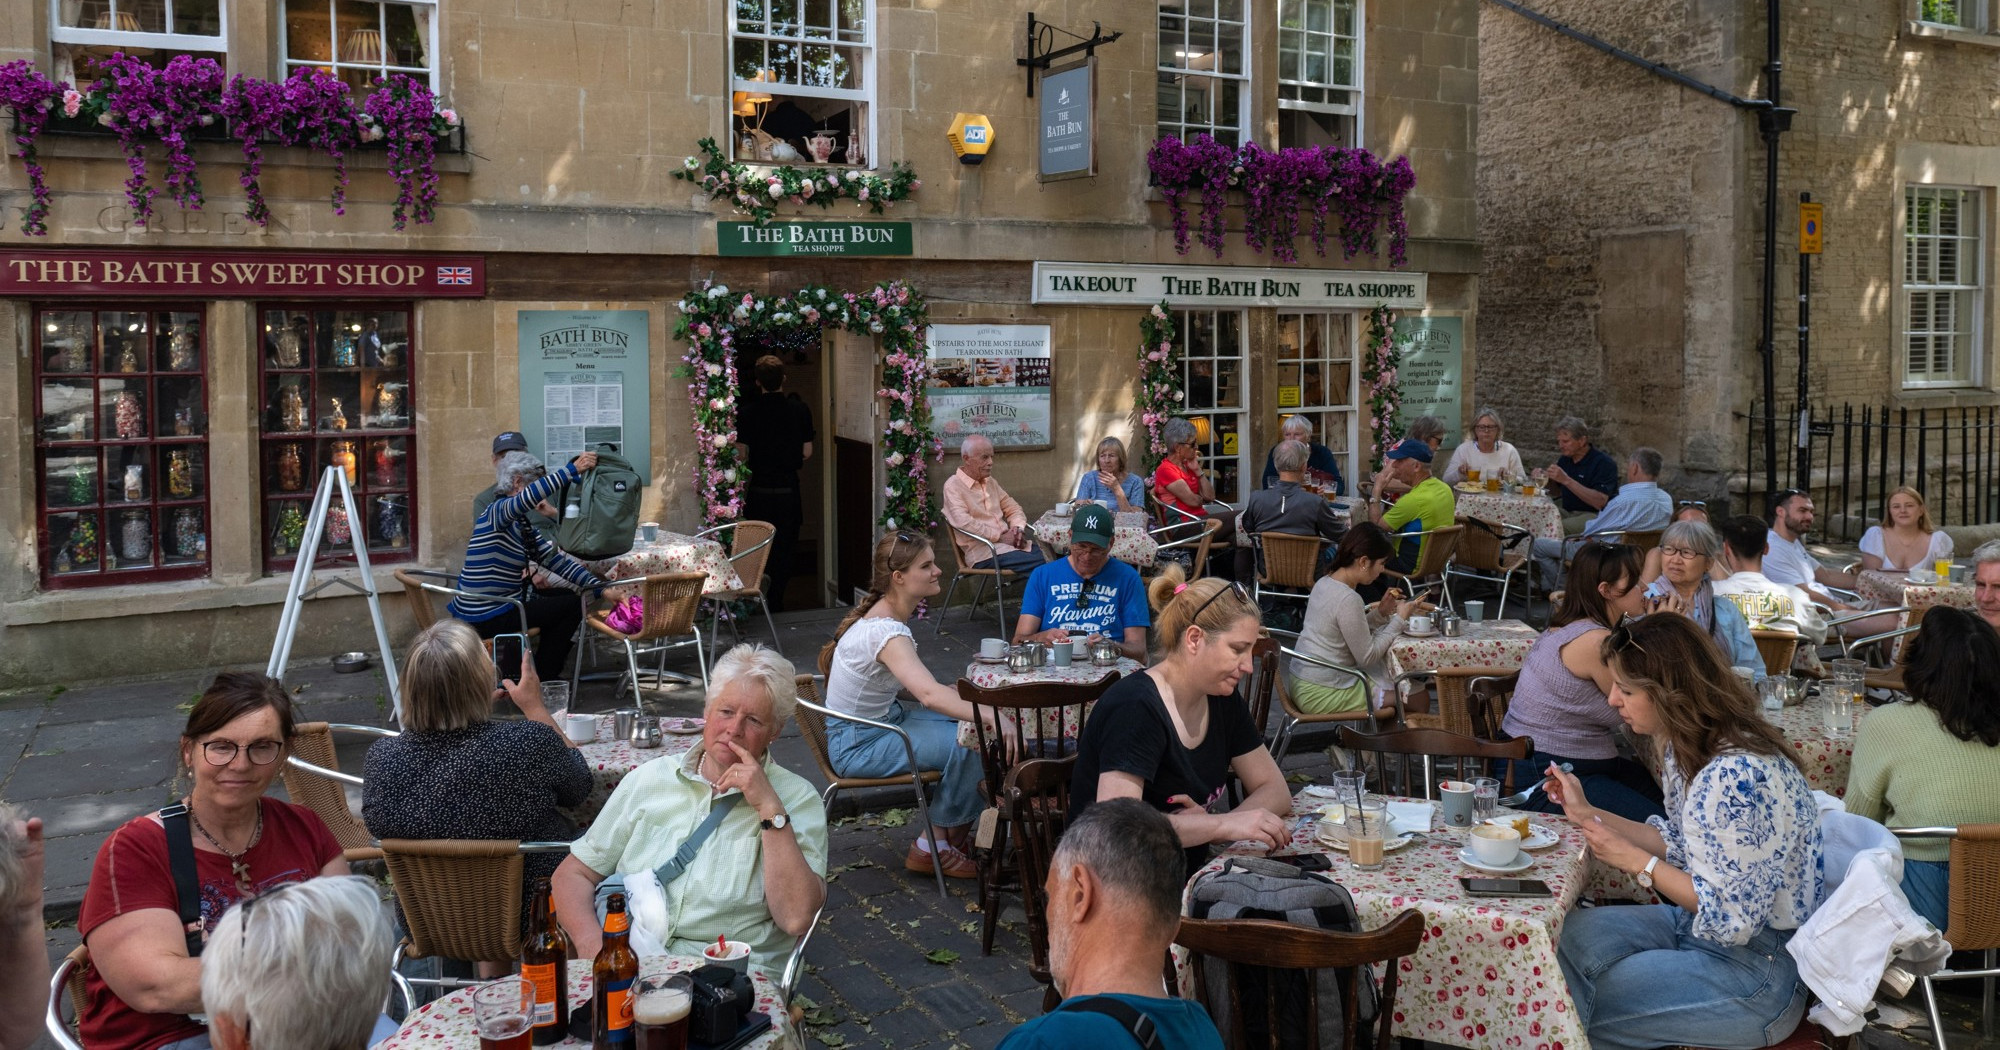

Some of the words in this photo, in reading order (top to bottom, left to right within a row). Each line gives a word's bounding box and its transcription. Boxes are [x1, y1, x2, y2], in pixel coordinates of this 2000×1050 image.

[1058, 111, 1069, 122] THE
[965, 129, 986, 140] ADT
[1047, 125, 1066, 139] BATH
[1067, 121, 1082, 135] BUN
[97, 205, 298, 237] GREEN
[738, 225, 784, 243] THE
[788, 225, 845, 243] BATH
[850, 225, 894, 243] BUN
[9, 260, 93, 283] THE
[101, 261, 202, 284] BATH
[211, 262, 331, 285] SWEET
[337, 264, 425, 286] SHOP
[1049, 275, 1136, 293] TAKEOUT
[1162, 276, 1202, 296] THE
[1206, 277, 1257, 297] BATH
[1260, 278, 1301, 298] BUN
[1324, 281, 1355, 298] TEA
[1358, 283, 1415, 298] SHOPPE
[540, 329, 586, 350] BATH
[592, 329, 629, 348] BUN
[1430, 331, 1451, 344] BUN
[1407, 369, 1430, 379] original
[1430, 369, 1444, 377] 1761
[1424, 396, 1438, 404] Take
[1439, 396, 1453, 404] Away
[961, 404, 990, 420] BATH
[993, 404, 1018, 418] BUN
[985, 430, 1007, 438] English
[1085, 515, 1098, 529] NY
[1051, 583, 1118, 597] PREUM
[1724, 593, 1795, 617] THENA
[1048, 604, 1116, 624] Havana
